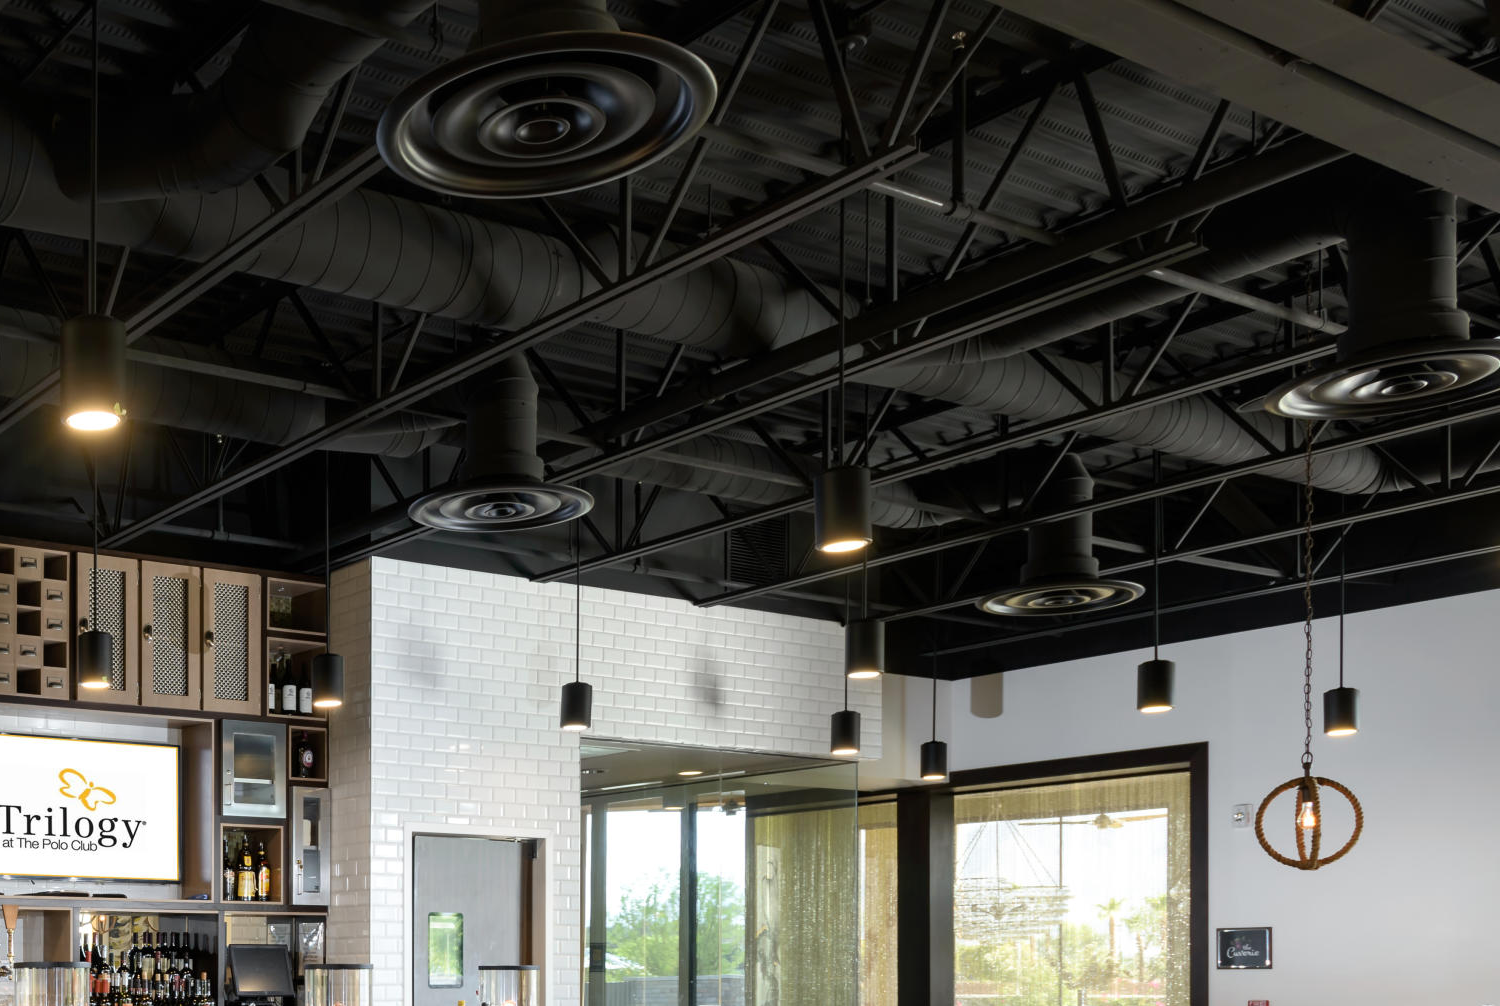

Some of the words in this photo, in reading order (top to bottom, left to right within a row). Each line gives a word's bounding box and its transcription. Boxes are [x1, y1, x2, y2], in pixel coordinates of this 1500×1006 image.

[2, 837, 14, 848] at
[16, 837, 39, 849] The
[42, 838, 68, 850] Polo
[71, 839, 98, 851] Club
